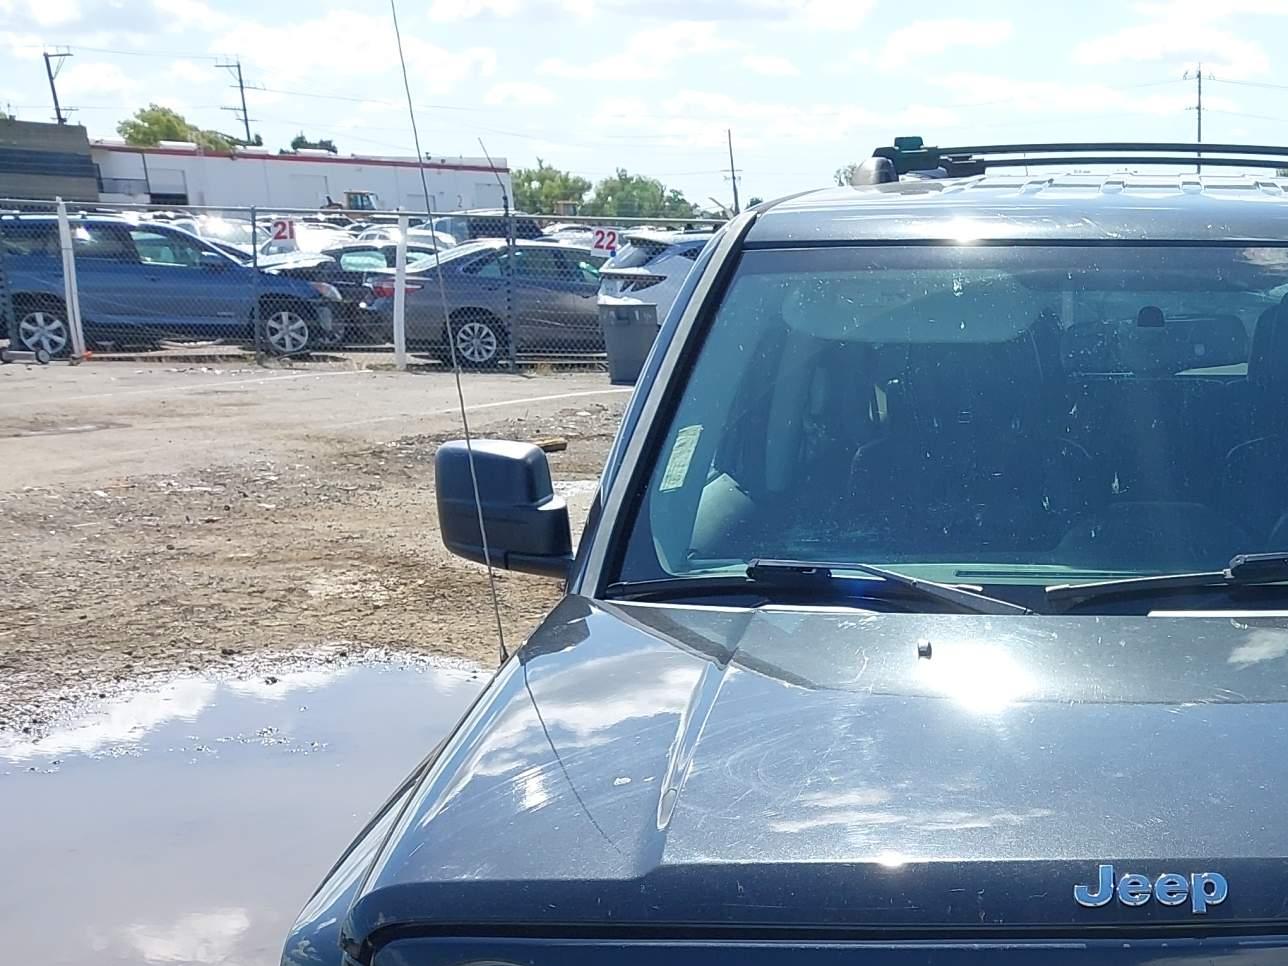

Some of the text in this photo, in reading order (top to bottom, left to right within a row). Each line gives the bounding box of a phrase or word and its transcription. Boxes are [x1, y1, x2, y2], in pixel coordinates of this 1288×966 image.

[274, 220, 294, 240] 21
[594, 230, 616, 250] 22
[1074, 864, 1228, 914] Jeep
